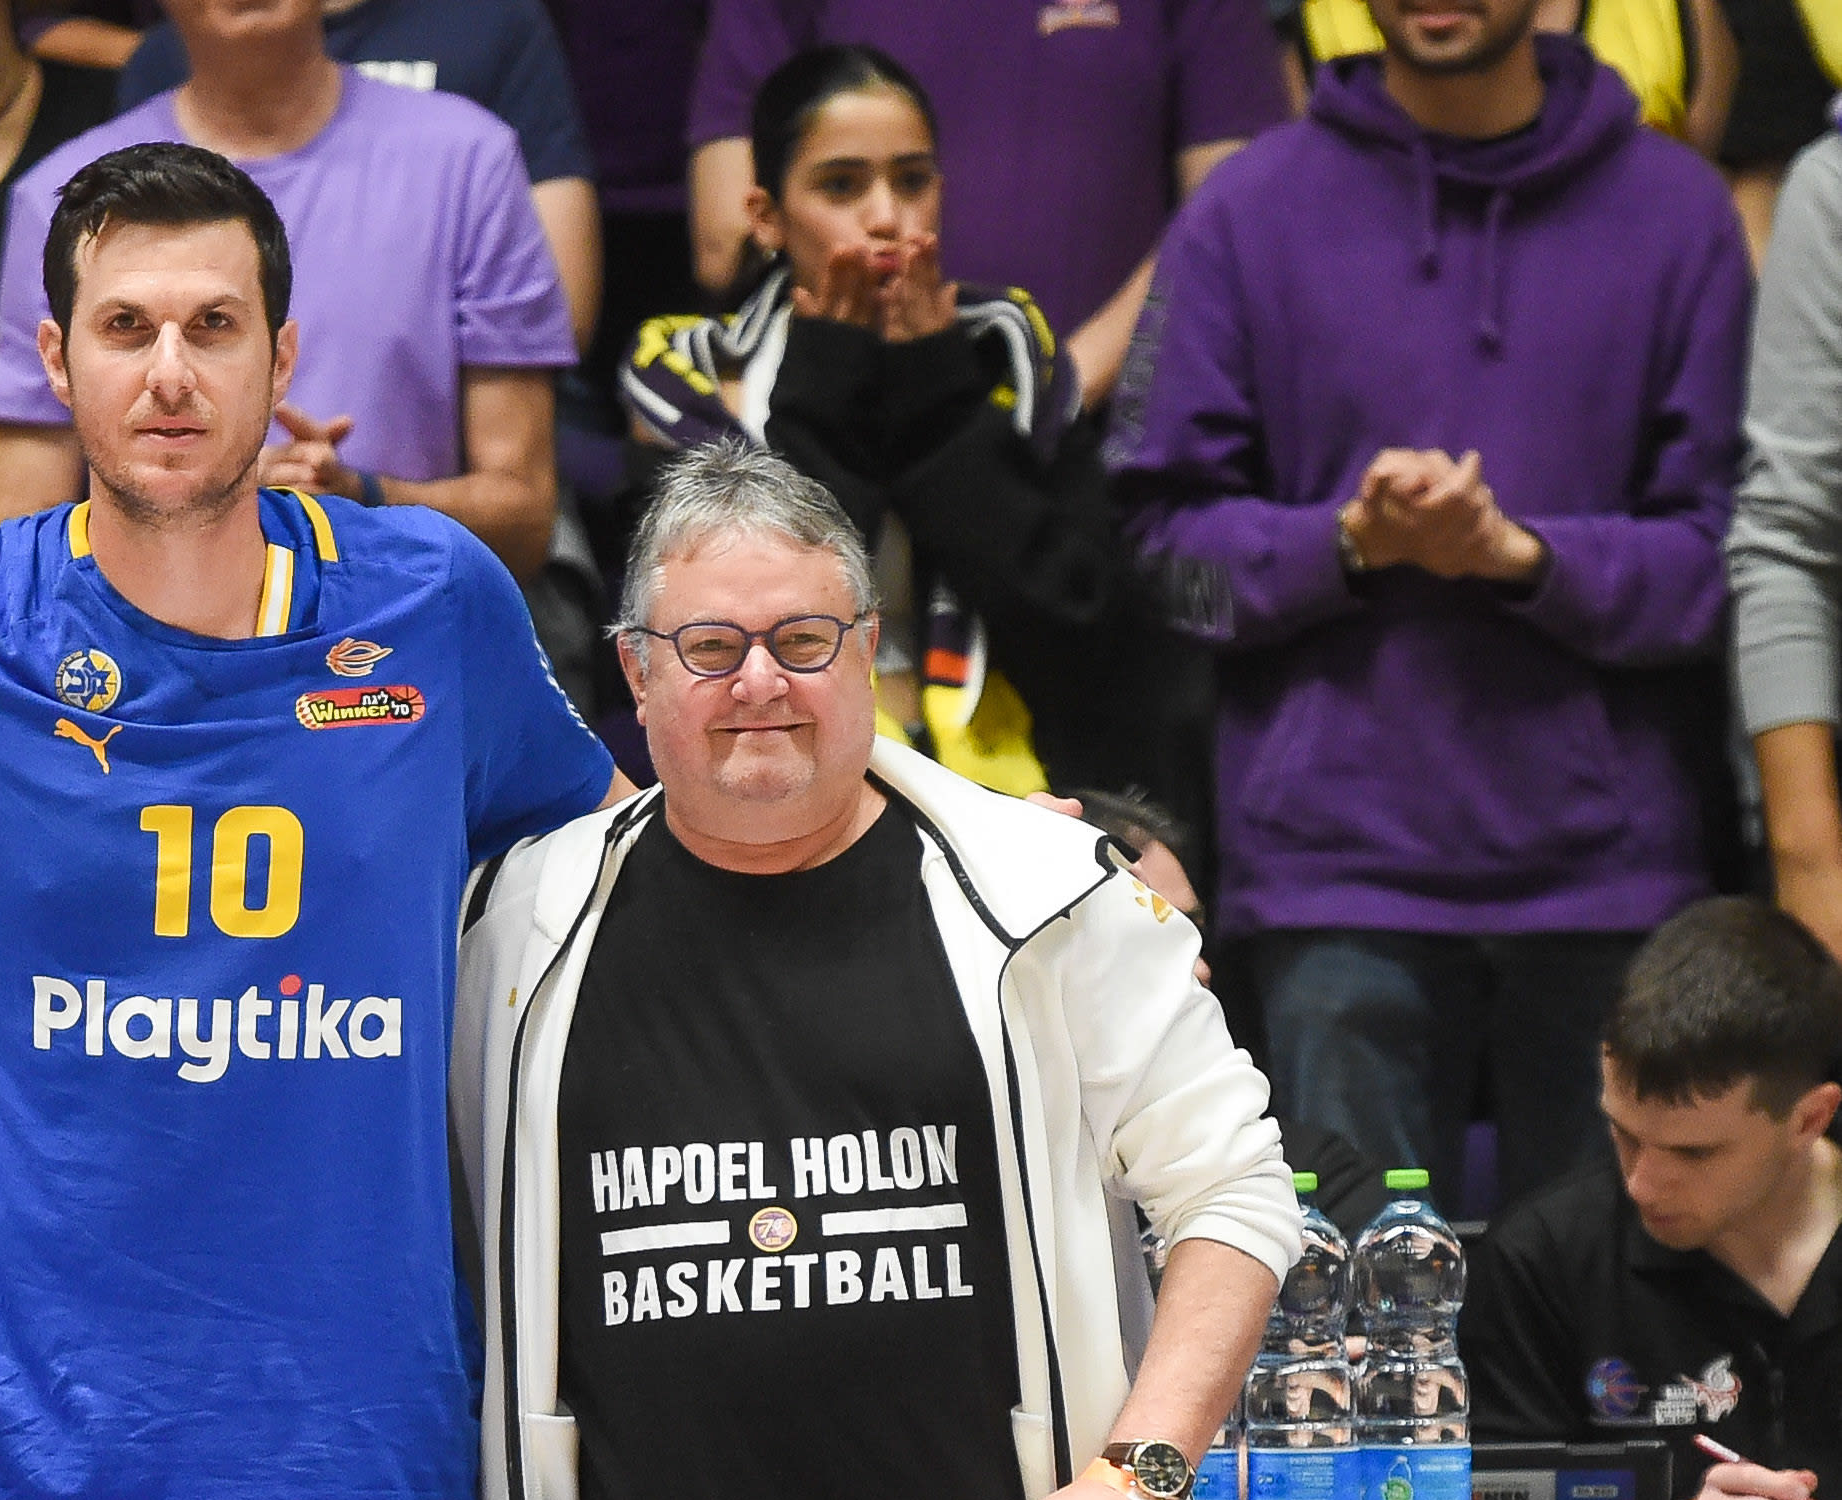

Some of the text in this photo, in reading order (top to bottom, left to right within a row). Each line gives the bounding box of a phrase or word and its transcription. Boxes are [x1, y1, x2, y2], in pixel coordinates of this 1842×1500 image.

[310, 700, 410, 722] Winner סל
[361, 690, 389, 706] ליגת
[140, 804, 304, 939] 10
[32, 974, 402, 1083] Playtika
[590, 1124, 959, 1213] HAPOEL HOLON
[602, 1243, 975, 1327] BASKETBALL
